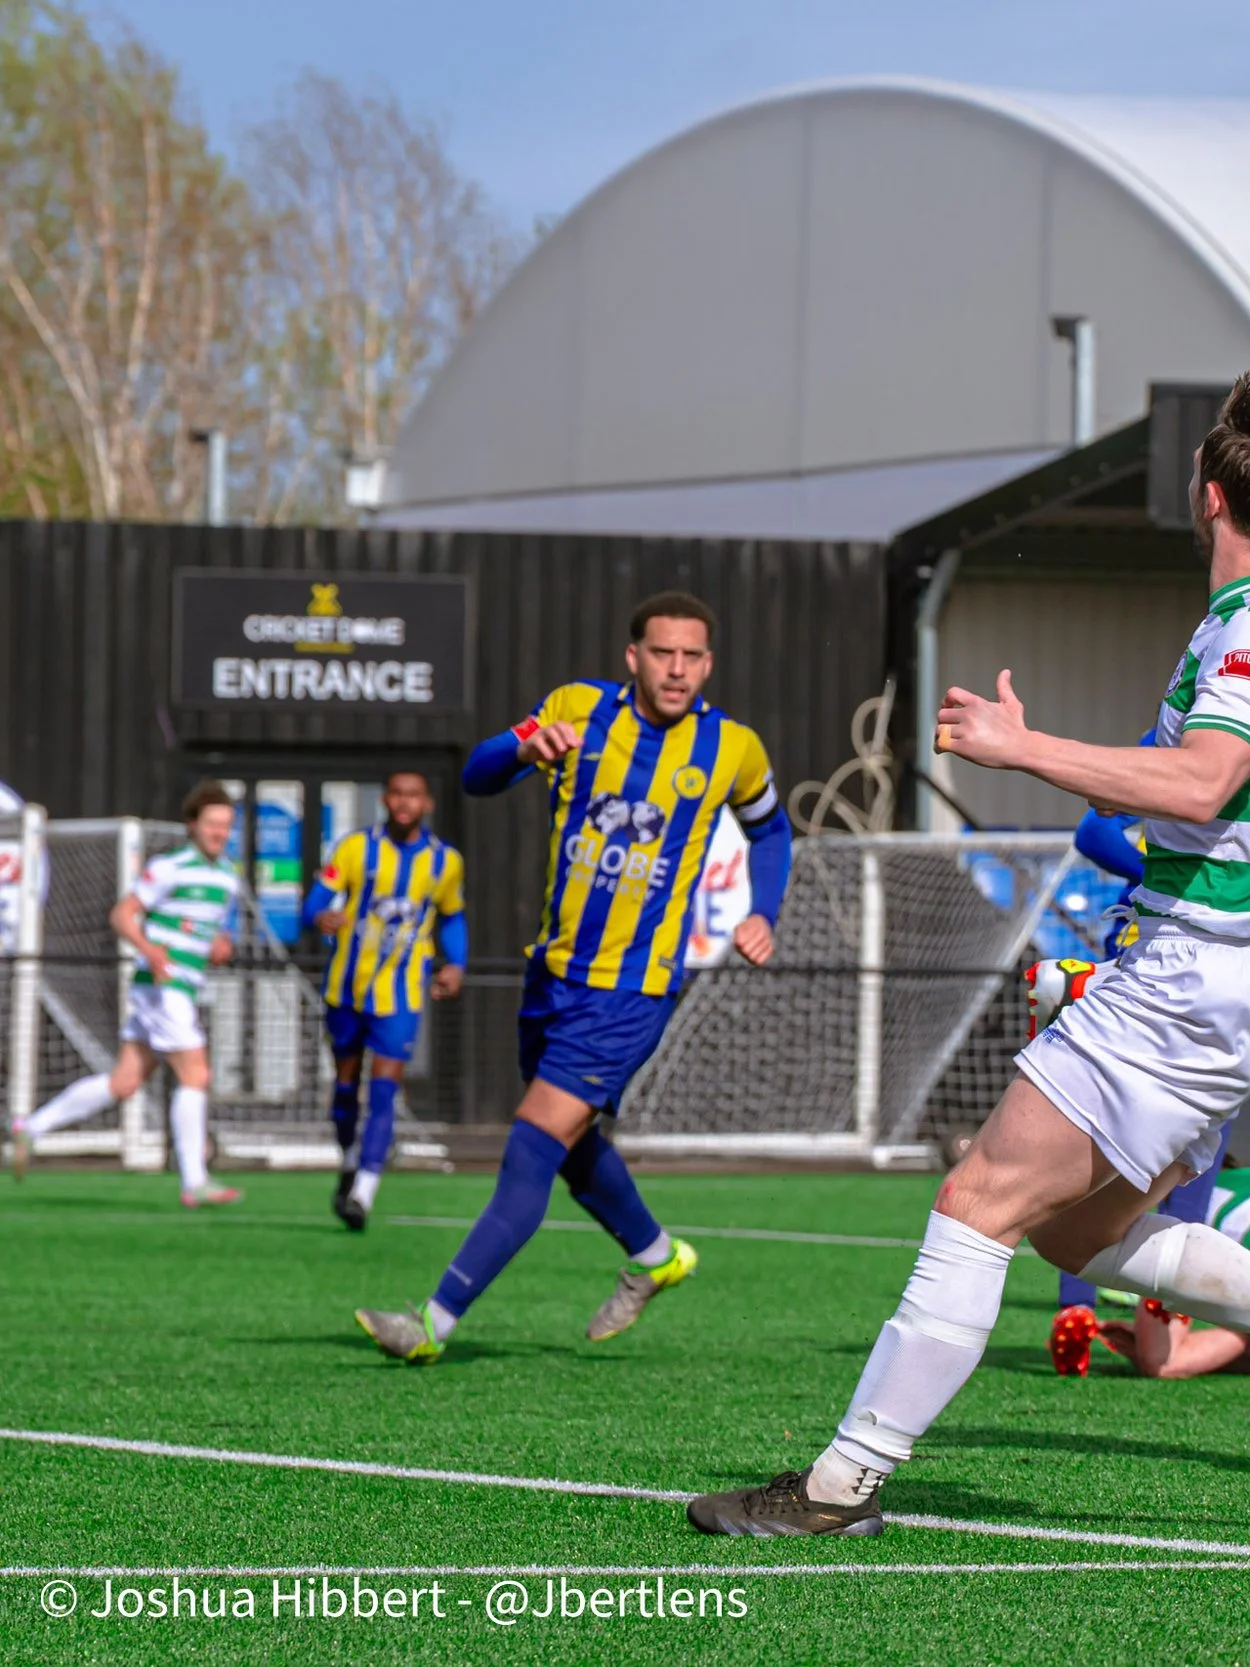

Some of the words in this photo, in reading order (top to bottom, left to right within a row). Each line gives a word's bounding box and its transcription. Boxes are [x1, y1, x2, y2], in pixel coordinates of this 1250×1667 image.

[243, 614, 335, 642] CRICKET
[337, 617, 405, 646] DOME
[212, 657, 434, 702] ENTRANCE
[565, 833, 670, 888] GLOBE
